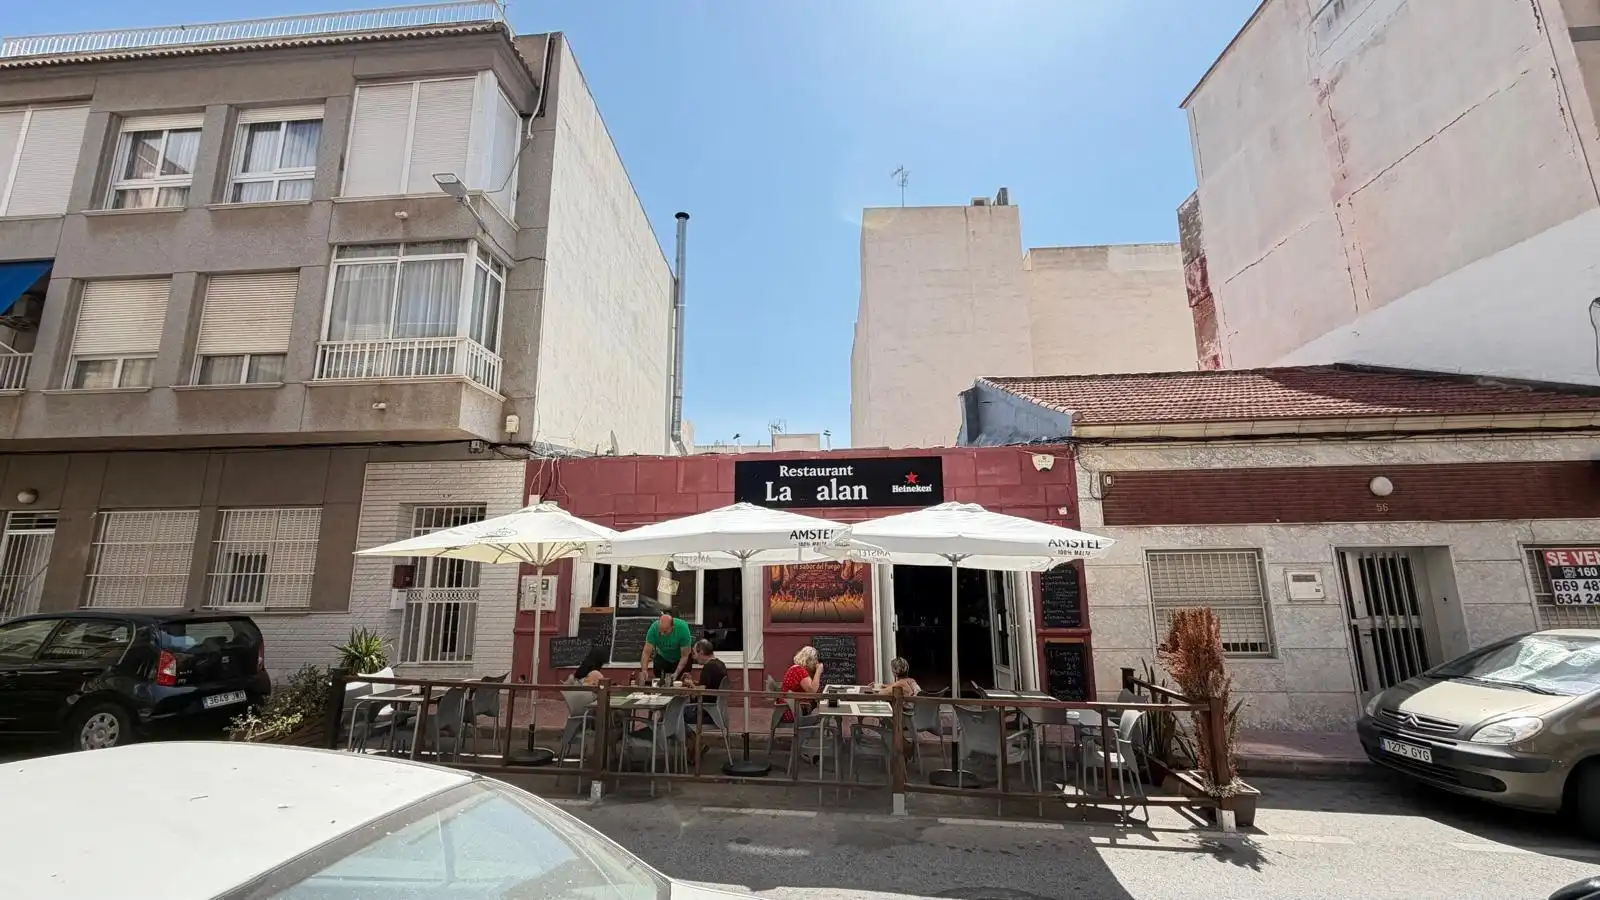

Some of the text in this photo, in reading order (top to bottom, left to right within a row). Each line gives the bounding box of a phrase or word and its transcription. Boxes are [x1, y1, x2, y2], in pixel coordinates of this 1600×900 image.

[779, 465, 854, 478] Restaurant
[765, 478, 868, 502] La alan
[892, 484, 932, 493] Heineken
[1376, 502, 1389, 513] 56
[1047, 538, 1102, 550] AMSTEL
[1546, 551, 1570, 566] SE
[816, 562, 824, 570] del
[824, 562, 841, 571] fuego
[1577, 567, 1598, 577] 160
[1554, 580, 1600, 592] 669 48
[1556, 593, 1582, 605] 634
[1386, 740, 1430, 761] 1275 GYG
